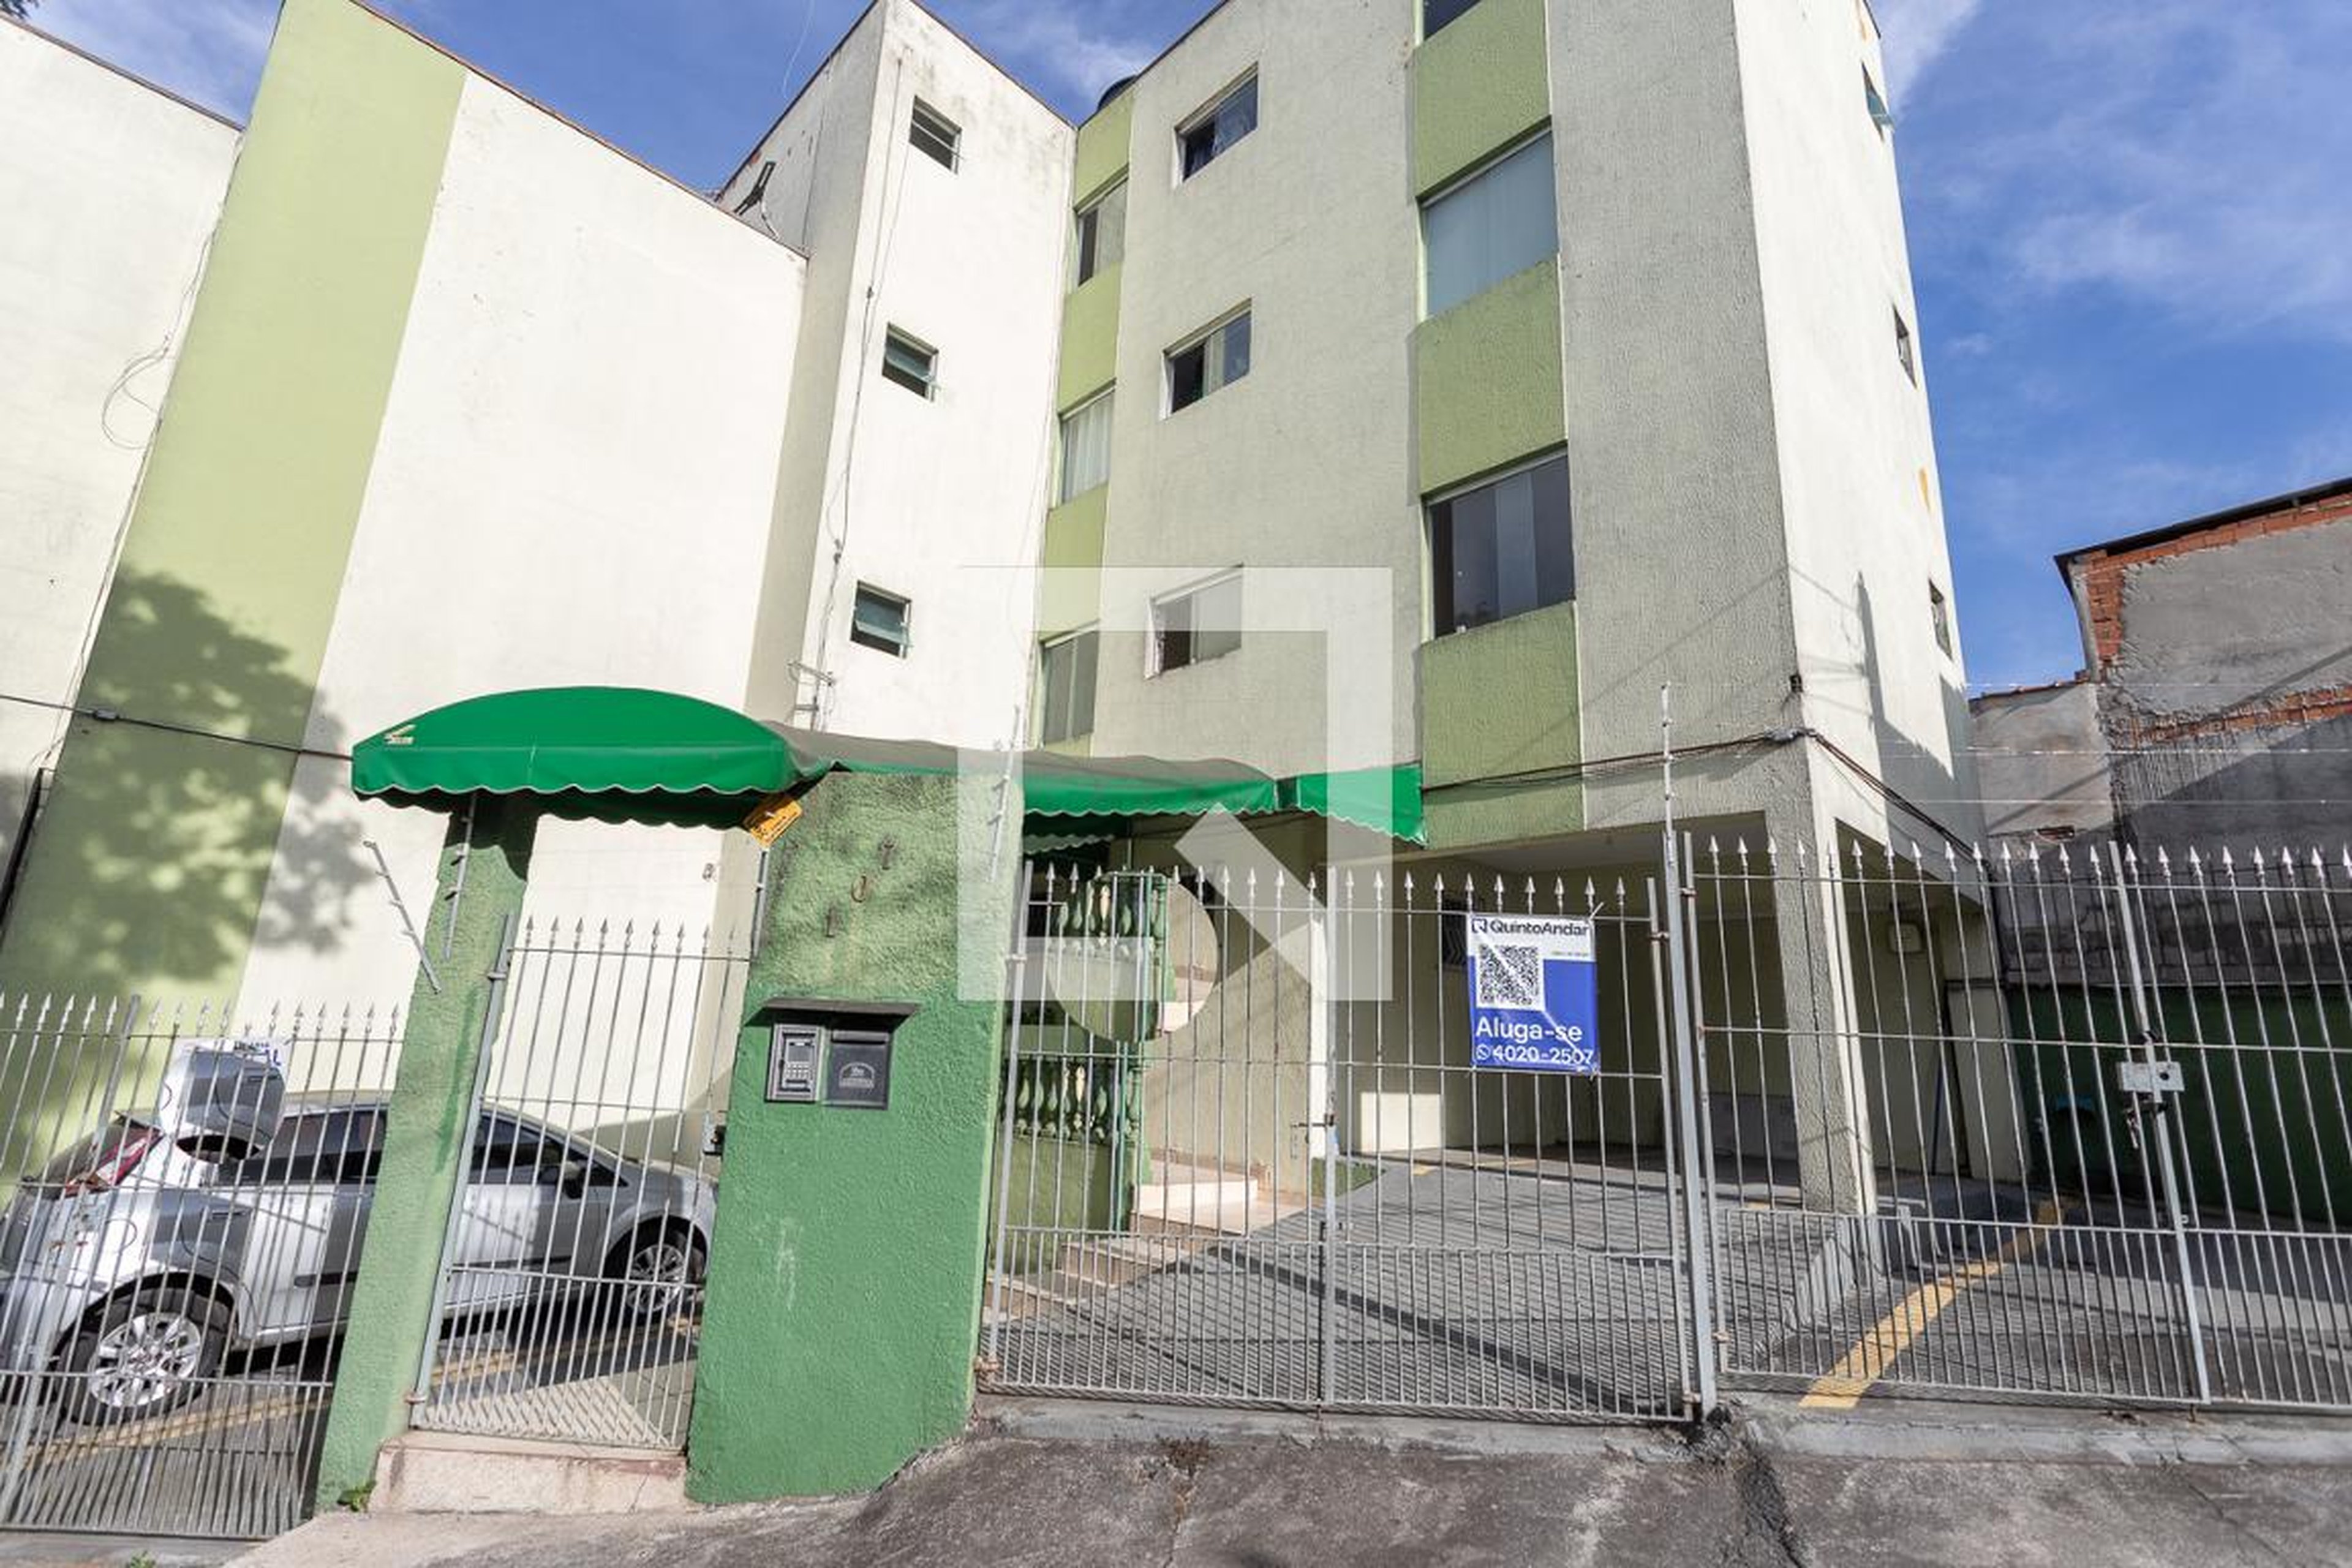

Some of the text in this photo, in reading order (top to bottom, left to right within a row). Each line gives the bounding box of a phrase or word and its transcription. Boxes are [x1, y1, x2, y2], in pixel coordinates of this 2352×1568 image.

[1490, 920, 1588, 936] QuintoAndar
[1476, 1016, 1582, 1044] Aluga-se
[1493, 1045, 1593, 1065] 4020-2507
